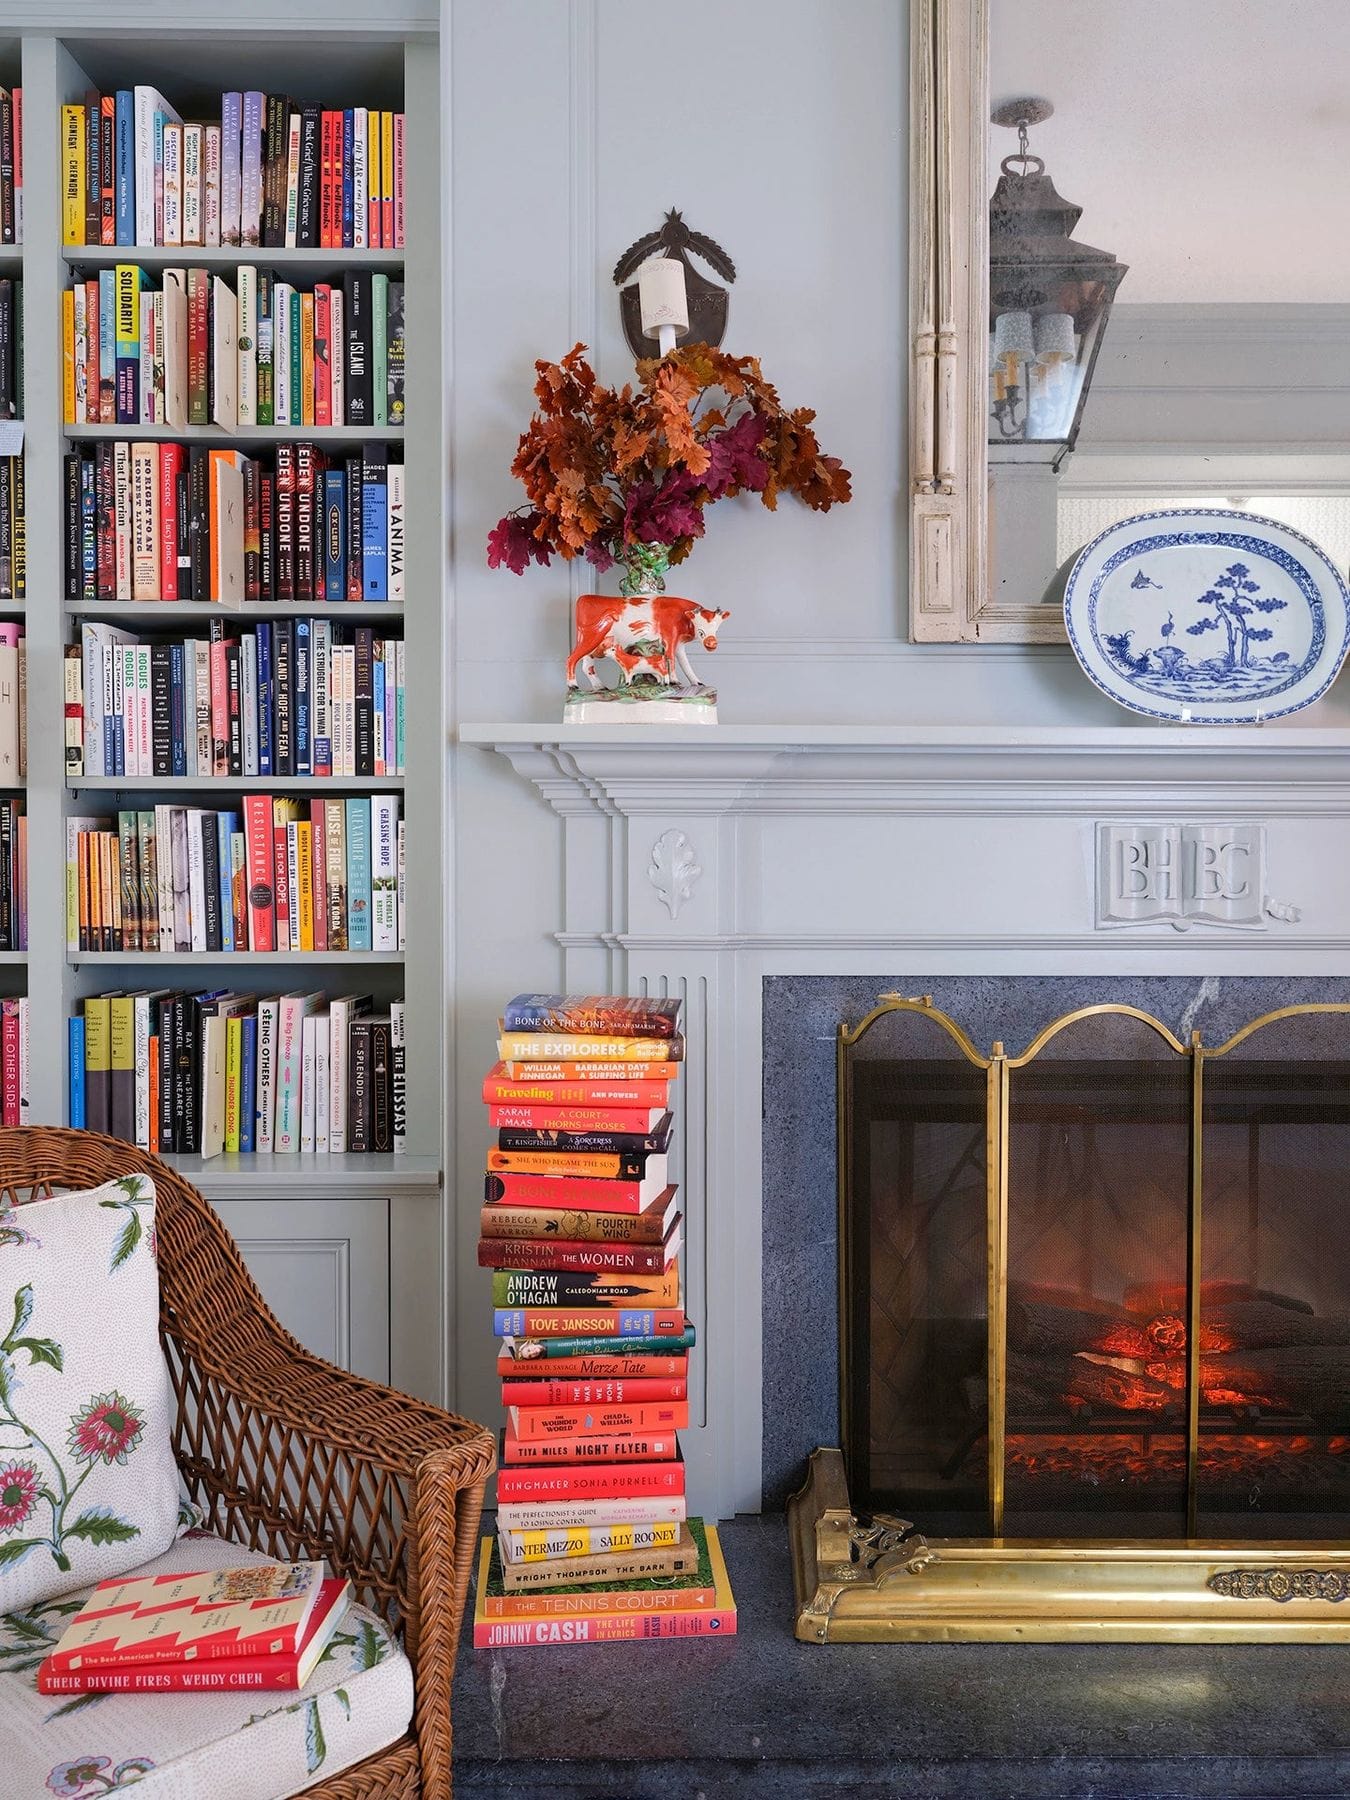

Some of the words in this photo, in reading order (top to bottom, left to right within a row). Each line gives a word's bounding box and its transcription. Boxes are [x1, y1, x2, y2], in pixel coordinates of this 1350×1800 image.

[68, 115, 77, 149] MIDNIGHT
[306, 121, 314, 141] Black
[68, 160, 77, 199] CHERNOBYL
[302, 189, 311, 225] Grievance
[355, 203, 363, 231] PUPPY
[121, 272, 132, 334] SOLIDARITY
[350, 342, 364, 375] ISLAND
[117, 451, 126, 474] That
[299, 449, 309, 486] EDEN
[70, 479, 78, 500] Come
[165, 453, 173, 507] Matrescence
[70, 503, 78, 523] Linton
[118, 478, 126, 526] Librarian
[262, 480, 270, 528] REBELLION
[15, 516, 25, 533] THE
[164, 519, 173, 539] Lucy
[299, 494, 310, 552] UNDONE
[1, 524, 9, 550] Moon?
[85, 516, 94, 562] FEATHER
[391, 515, 403, 576] ANIMA
[16, 539, 25, 575] REBELS
[70, 544, 78, 569] Johnson
[165, 541, 174, 565] Jones
[86, 567, 94, 597] THIEF
[138, 652, 147, 689] ROGUES
[278, 657, 287, 680] LAND
[297, 648, 307, 692] Languishing
[316, 652, 325, 690] STRUGGLE
[197, 668, 208, 700] BLACK
[279, 694, 288, 717] HOPE
[317, 692, 325, 705] FOR
[198, 705, 208, 729] FOLK
[298, 706, 307, 726] Corey
[317, 708, 325, 735] TAIWAN
[279, 734, 288, 757] FEAR
[299, 728, 307, 750] Keyes
[204, 820, 212, 836] Why
[328, 806, 340, 835] MUSE
[381, 808, 389, 842] CHASING
[253, 802, 266, 881] RESISTANCE
[352, 808, 363, 861] ALEXANDER
[329, 848, 341, 871] FIRE
[381, 846, 389, 866] HOPE
[278, 877, 286, 904] HOPE
[7, 1020, 15, 1039] THE
[262, 1009, 270, 1044] SEEING
[515, 1017, 540, 1026] BONE
[558, 1019, 577, 1027] THE
[395, 1051, 403, 1069] THE
[513, 1044, 542, 1055] THE
[544, 1044, 625, 1055] EXPLORERS
[7, 1044, 15, 1079] OTHER
[262, 1048, 270, 1086] OTHERS
[356, 1050, 364, 1096] SPLENDID
[7, 1085, 15, 1108] SIDE
[394, 1073, 406, 1131] ELISSAS
[496, 1087, 554, 1099] Traveling
[505, 1119, 532, 1127] MAAS
[544, 1120, 581, 1128] THORNS
[491, 1215, 538, 1224] REBECCA
[597, 1219, 637, 1230] FOURTH
[495, 1228, 534, 1236] YARROS
[602, 1229, 630, 1238] WING
[505, 1244, 554, 1256] KRISTIN
[562, 1255, 577, 1263] THE
[580, 1254, 634, 1266] WOMEN
[503, 1257, 556, 1267] HANNAH
[508, 1276, 558, 1290] ANDREW
[529, 1319, 559, 1331] TOVE
[562, 1319, 614, 1331] JANSSON
[581, 1361, 618, 1373] Merze
[622, 1361, 646, 1373] Tate
[542, 1447, 568, 1455] MILES
[576, 1445, 608, 1455] NIGHT
[615, 1443, 647, 1454] FLYER
[505, 1481, 569, 1490] KINGMAKER
[574, 1480, 608, 1488] SONIA
[613, 1477, 658, 1486] PURNELL
[515, 1540, 583, 1556] INTERMEZZO
[600, 1536, 633, 1547] SALLY
[635, 1530, 676, 1543] ROONEY
[556, 1569, 607, 1578] THOMPSON
[516, 1603, 536, 1611] THE
[542, 1599, 608, 1611] TENNIS
[616, 1595, 679, 1609] COURT
[488, 1624, 531, 1645] JOHNNY
[535, 1621, 589, 1642] CASH
[596, 1621, 614, 1629] THE
[617, 1619, 635, 1627] LIFE
[597, 1630, 605, 1639] IN
[607, 1629, 636, 1638] LYRICS
[119, 1653, 154, 1661] American
[156, 1651, 181, 1660] Poetry
[46, 1678, 81, 1688] THEIR
[87, 1676, 130, 1687] DIVINE
[136, 1675, 171, 1687] FIRES
[183, 1674, 226, 1685] WENDY
[229, 1673, 263, 1684] CHEN
